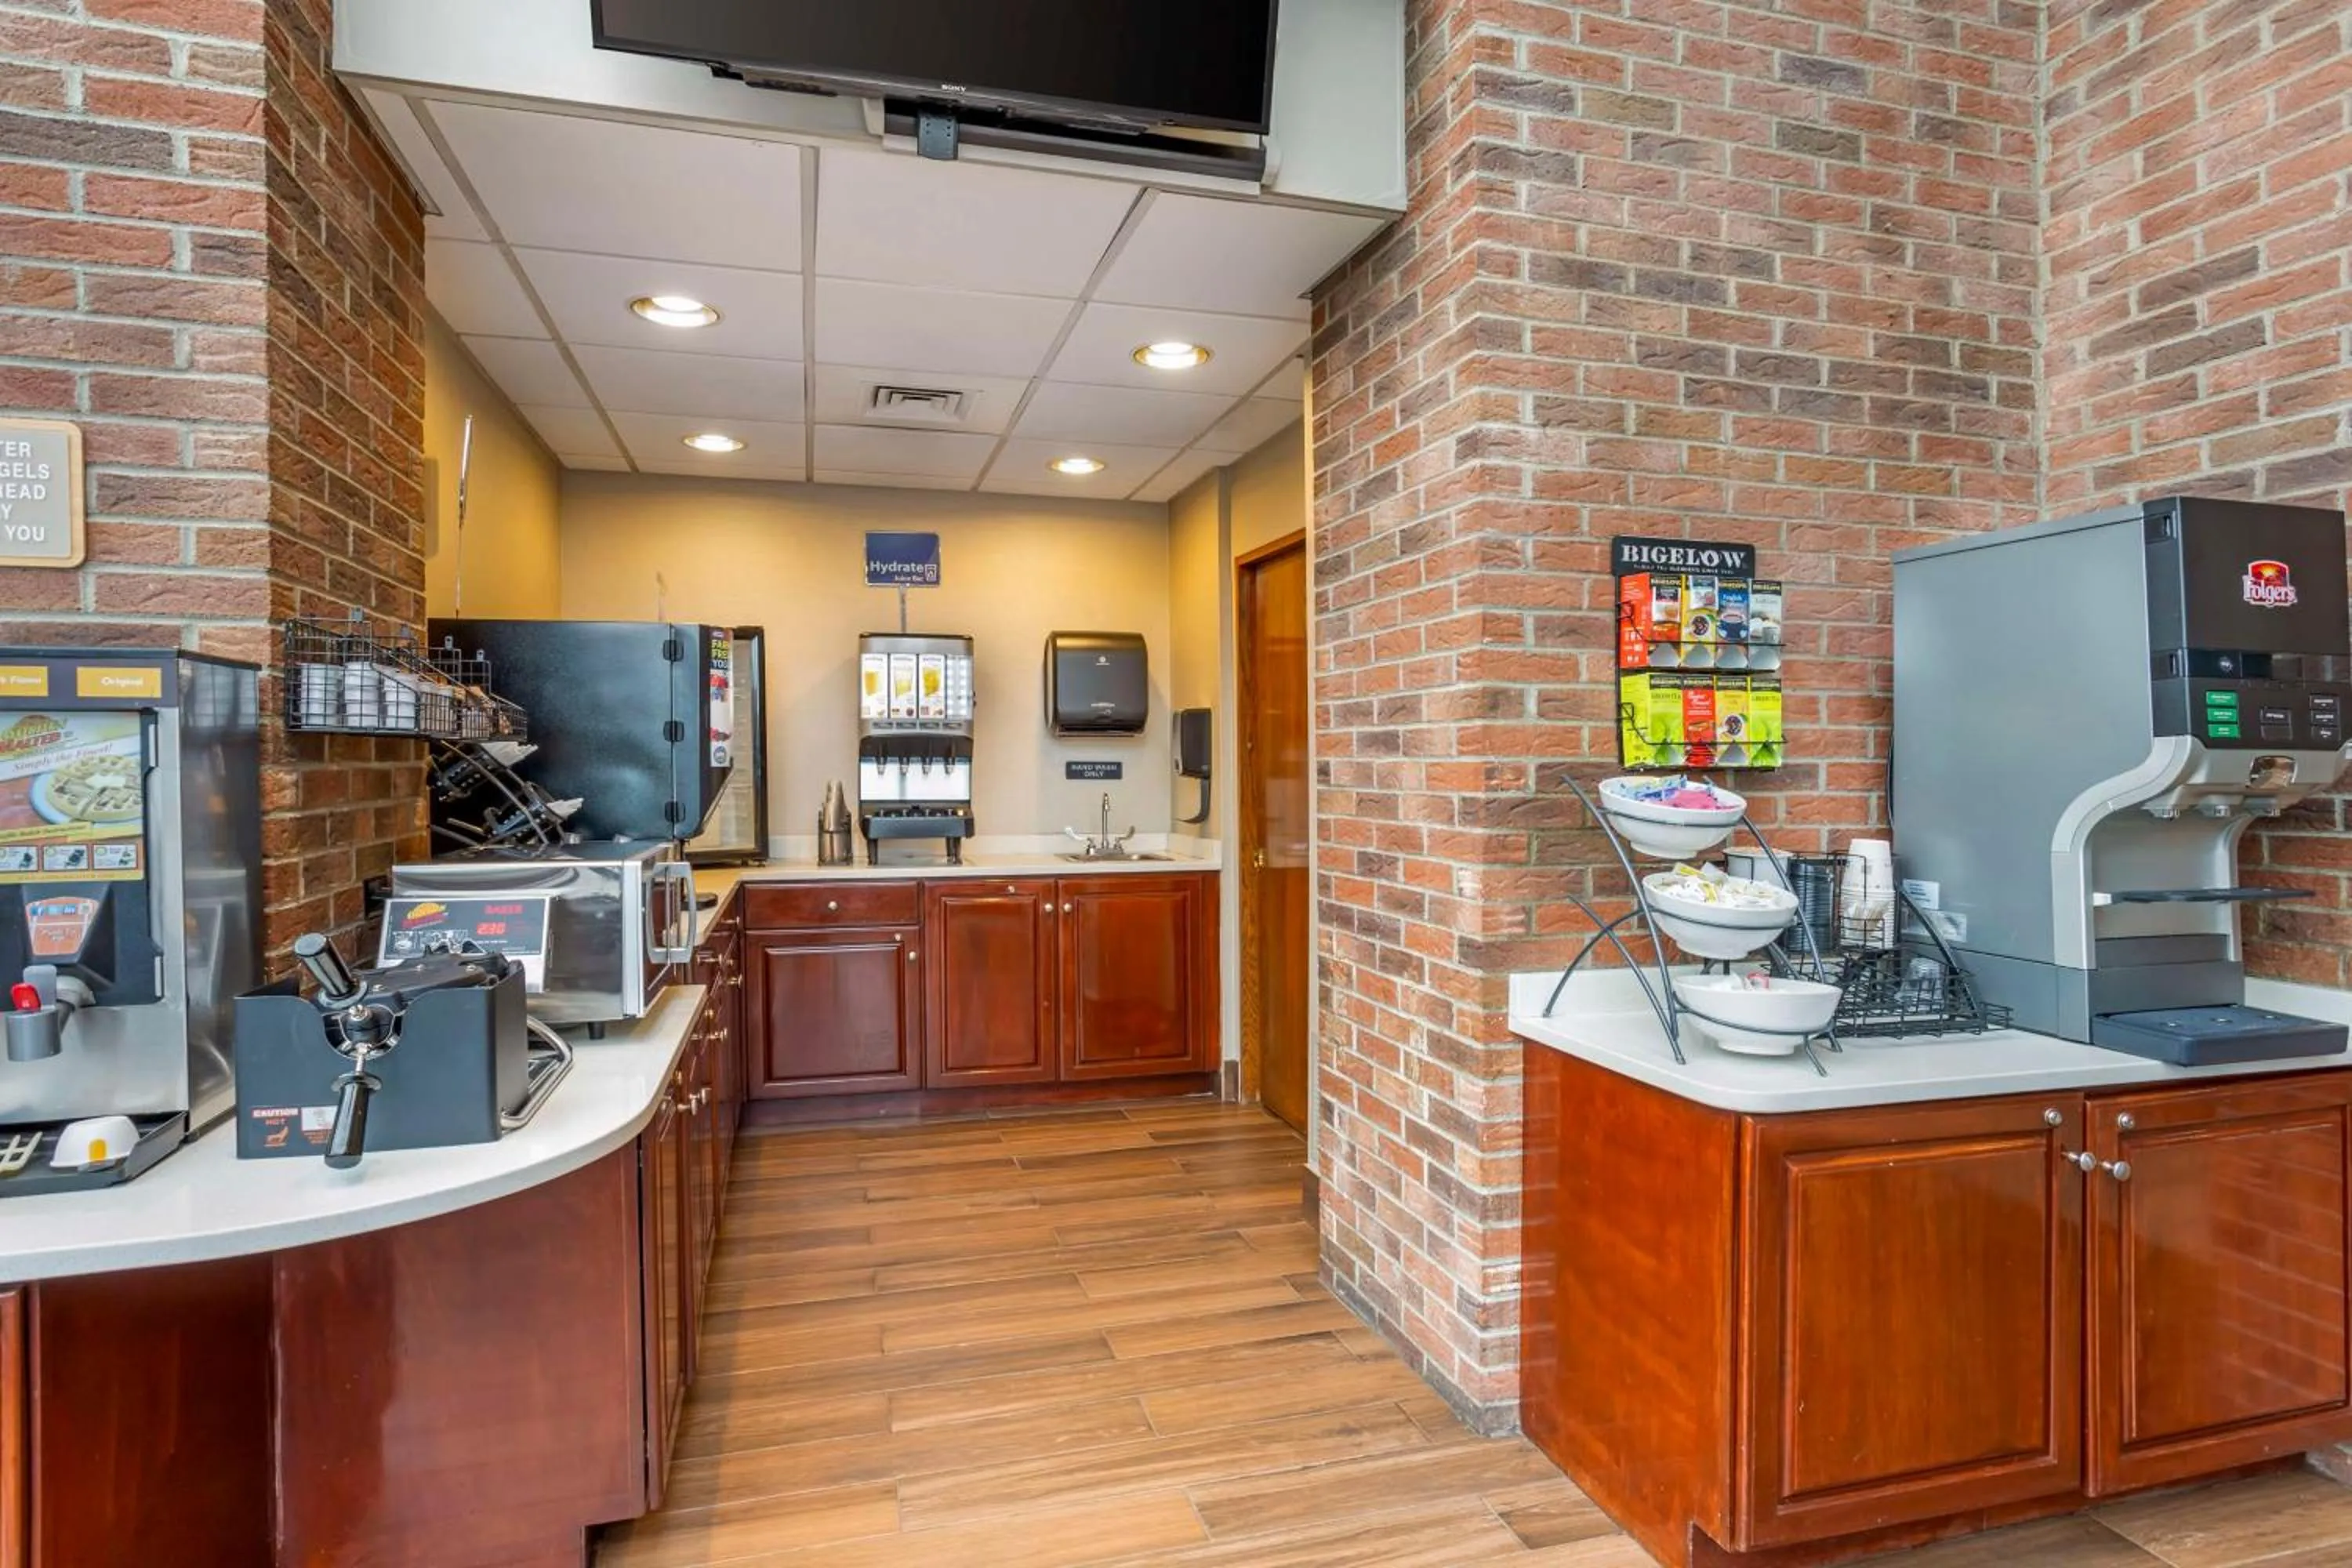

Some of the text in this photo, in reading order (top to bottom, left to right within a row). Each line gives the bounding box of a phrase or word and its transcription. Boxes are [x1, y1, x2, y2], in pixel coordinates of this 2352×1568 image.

[0, 483, 46, 500] EAD
[5, 524, 45, 542] YOU
[1621, 543, 1747, 569] BIGELOW
[869, 560, 924, 575] Hydrate
[2243, 575, 2296, 604] Folgers
[252, 1107, 299, 1118] CAUTION
